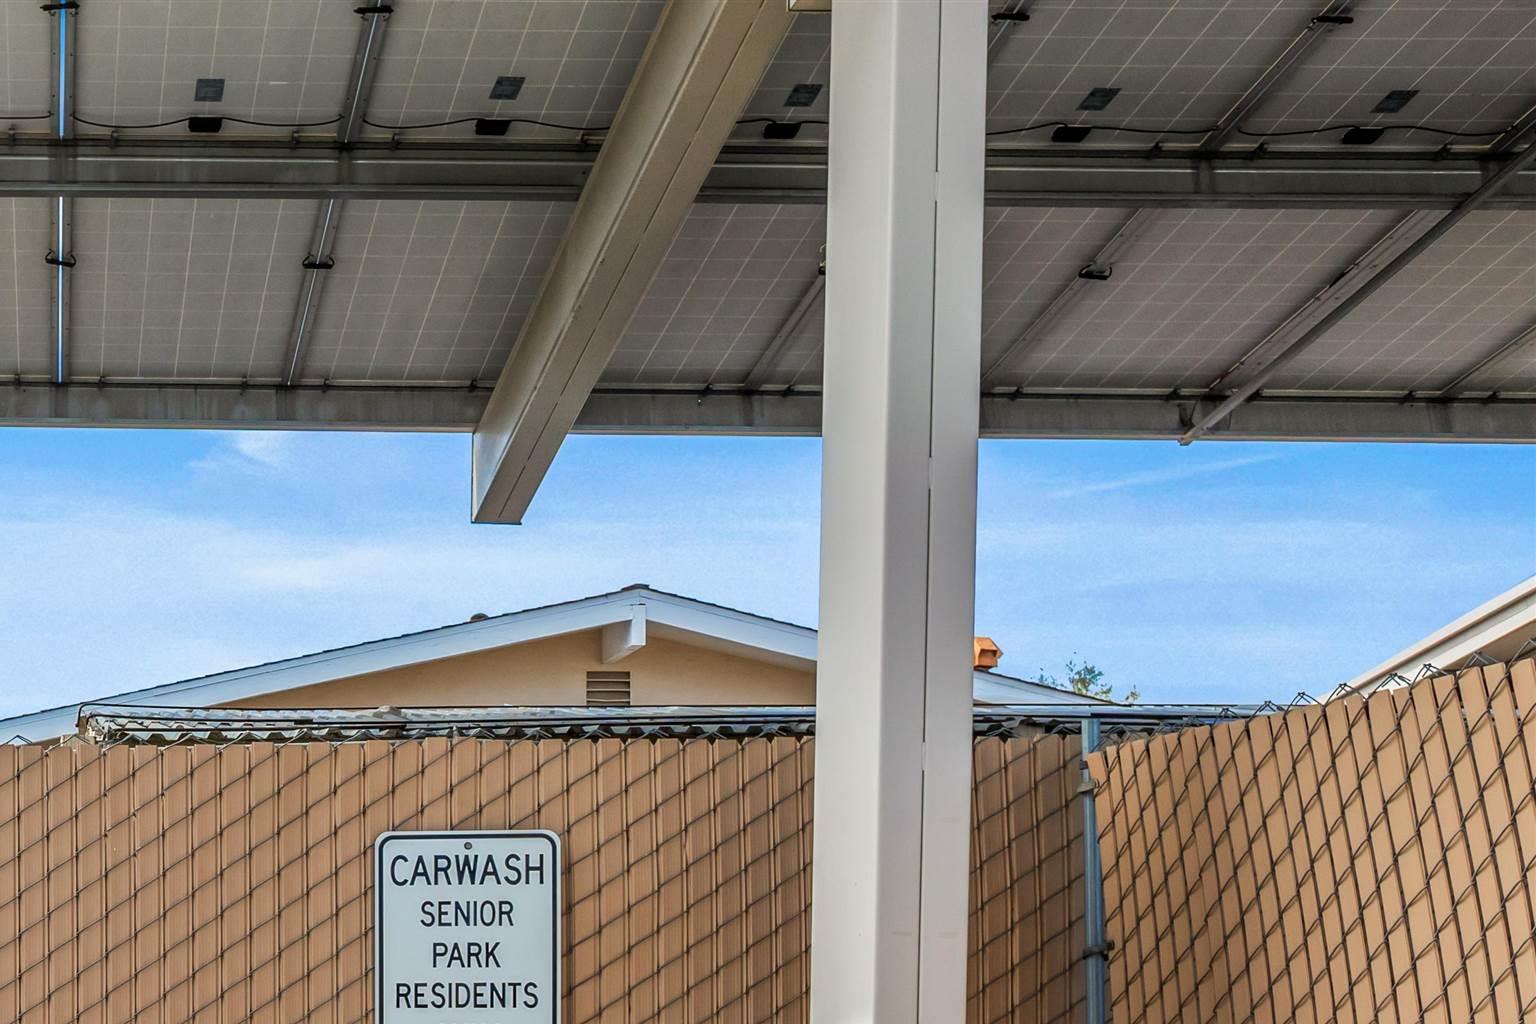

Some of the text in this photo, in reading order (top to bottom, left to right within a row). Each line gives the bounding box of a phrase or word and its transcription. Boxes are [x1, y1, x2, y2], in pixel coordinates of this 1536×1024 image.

[390, 854, 545, 887] CARWASH
[420, 900, 514, 927] SENIOR
[432, 942, 501, 968] PARK
[395, 982, 539, 1009] RESIDENTS
